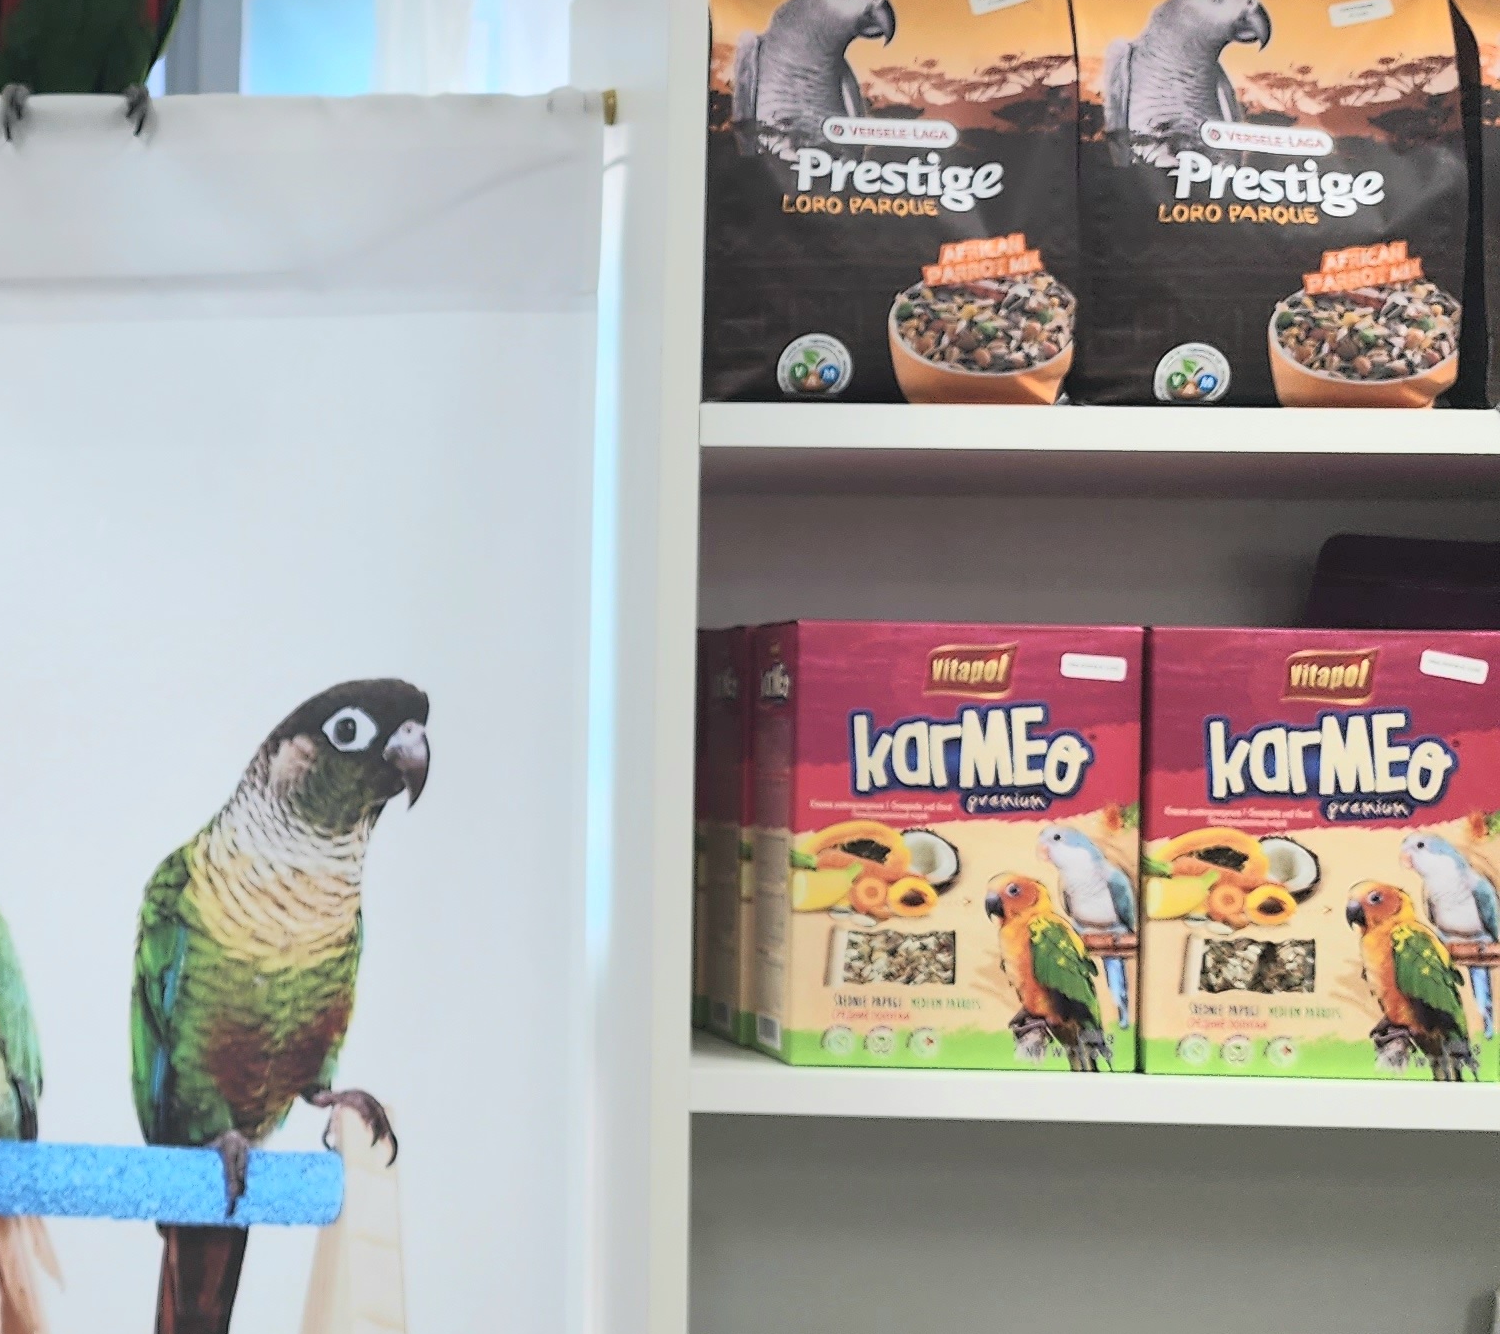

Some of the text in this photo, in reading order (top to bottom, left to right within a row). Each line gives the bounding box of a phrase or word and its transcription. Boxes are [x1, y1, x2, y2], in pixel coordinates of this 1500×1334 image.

[790, 148, 1004, 213] Prestige
[1167, 150, 1385, 217] Prestige
[781, 194, 939, 217] LORO PARQUE
[1158, 203, 1319, 225] LORO PARQUE
[966, 793, 1047, 813] premium
[1326, 801, 1409, 822] premium
